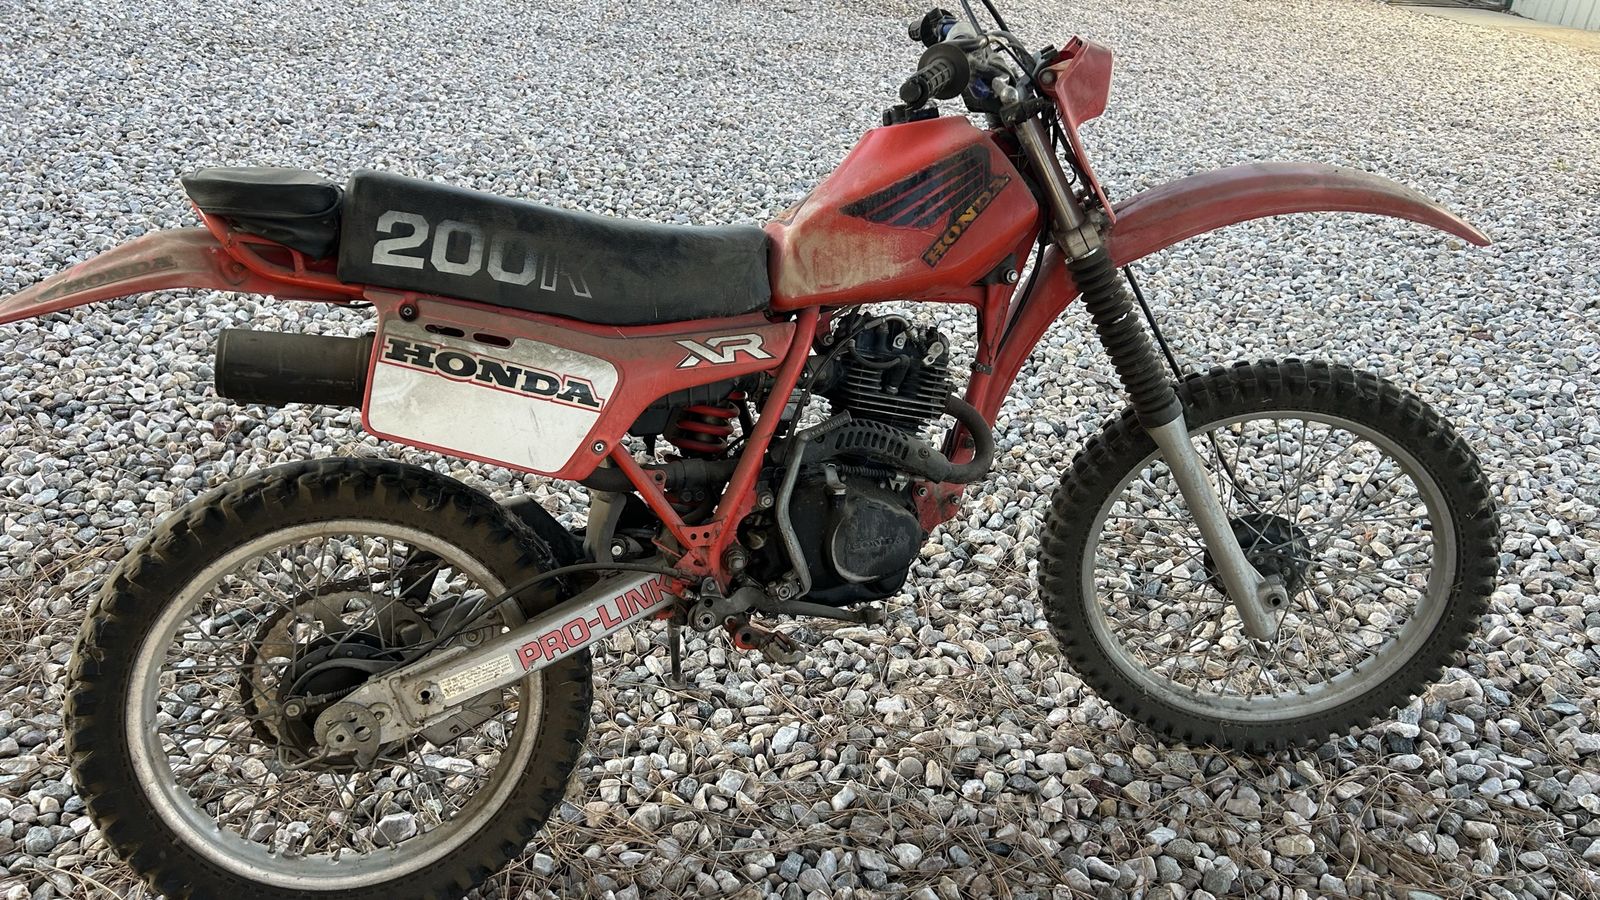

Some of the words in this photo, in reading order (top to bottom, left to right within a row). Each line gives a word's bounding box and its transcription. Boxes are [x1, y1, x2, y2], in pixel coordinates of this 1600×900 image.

[926, 175, 1010, 263] HONDA
[384, 338, 600, 408] HONDA
[675, 333, 777, 368] XR
[517, 574, 673, 671] PRO-LINK
